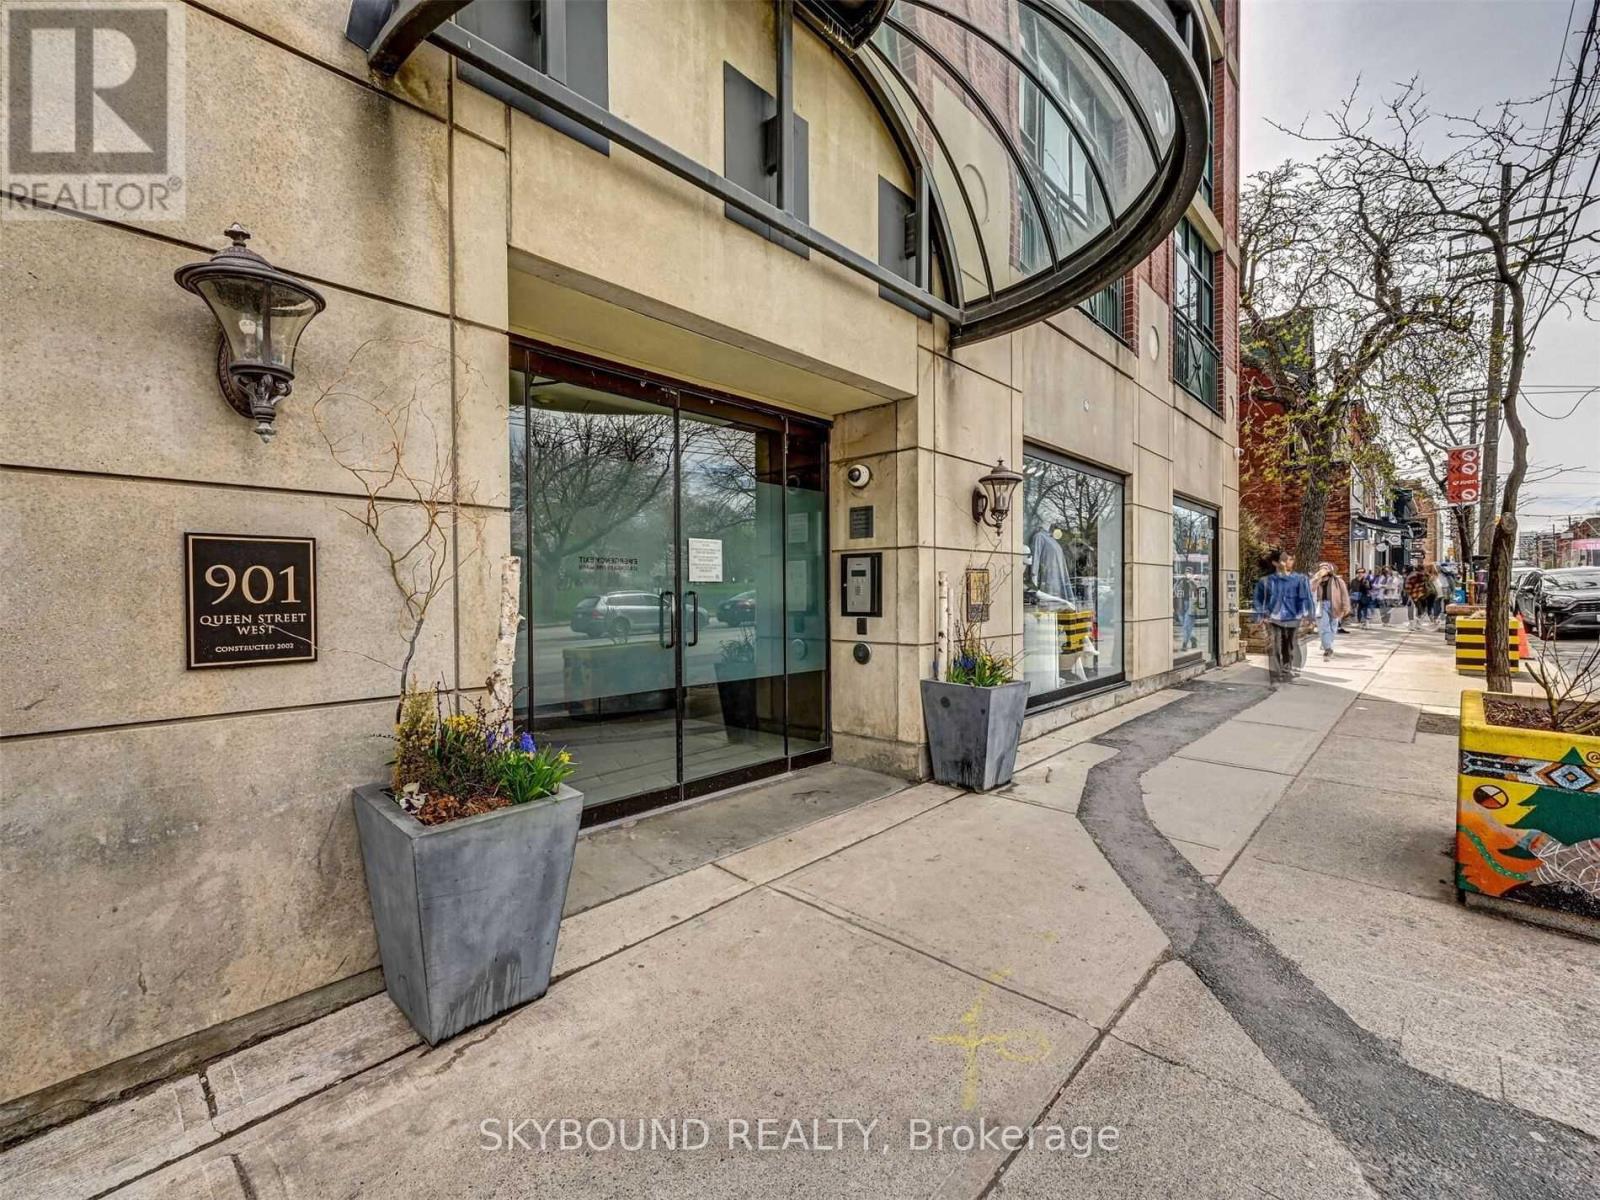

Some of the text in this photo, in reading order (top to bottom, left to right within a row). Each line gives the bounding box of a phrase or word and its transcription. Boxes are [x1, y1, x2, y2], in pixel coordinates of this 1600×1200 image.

[205, 564, 301, 605] 901
[200, 613, 307, 627] QUEEN STREET
[236, 625, 275, 635] WEST
[215, 643, 275, 653] CONSTRUCTED
